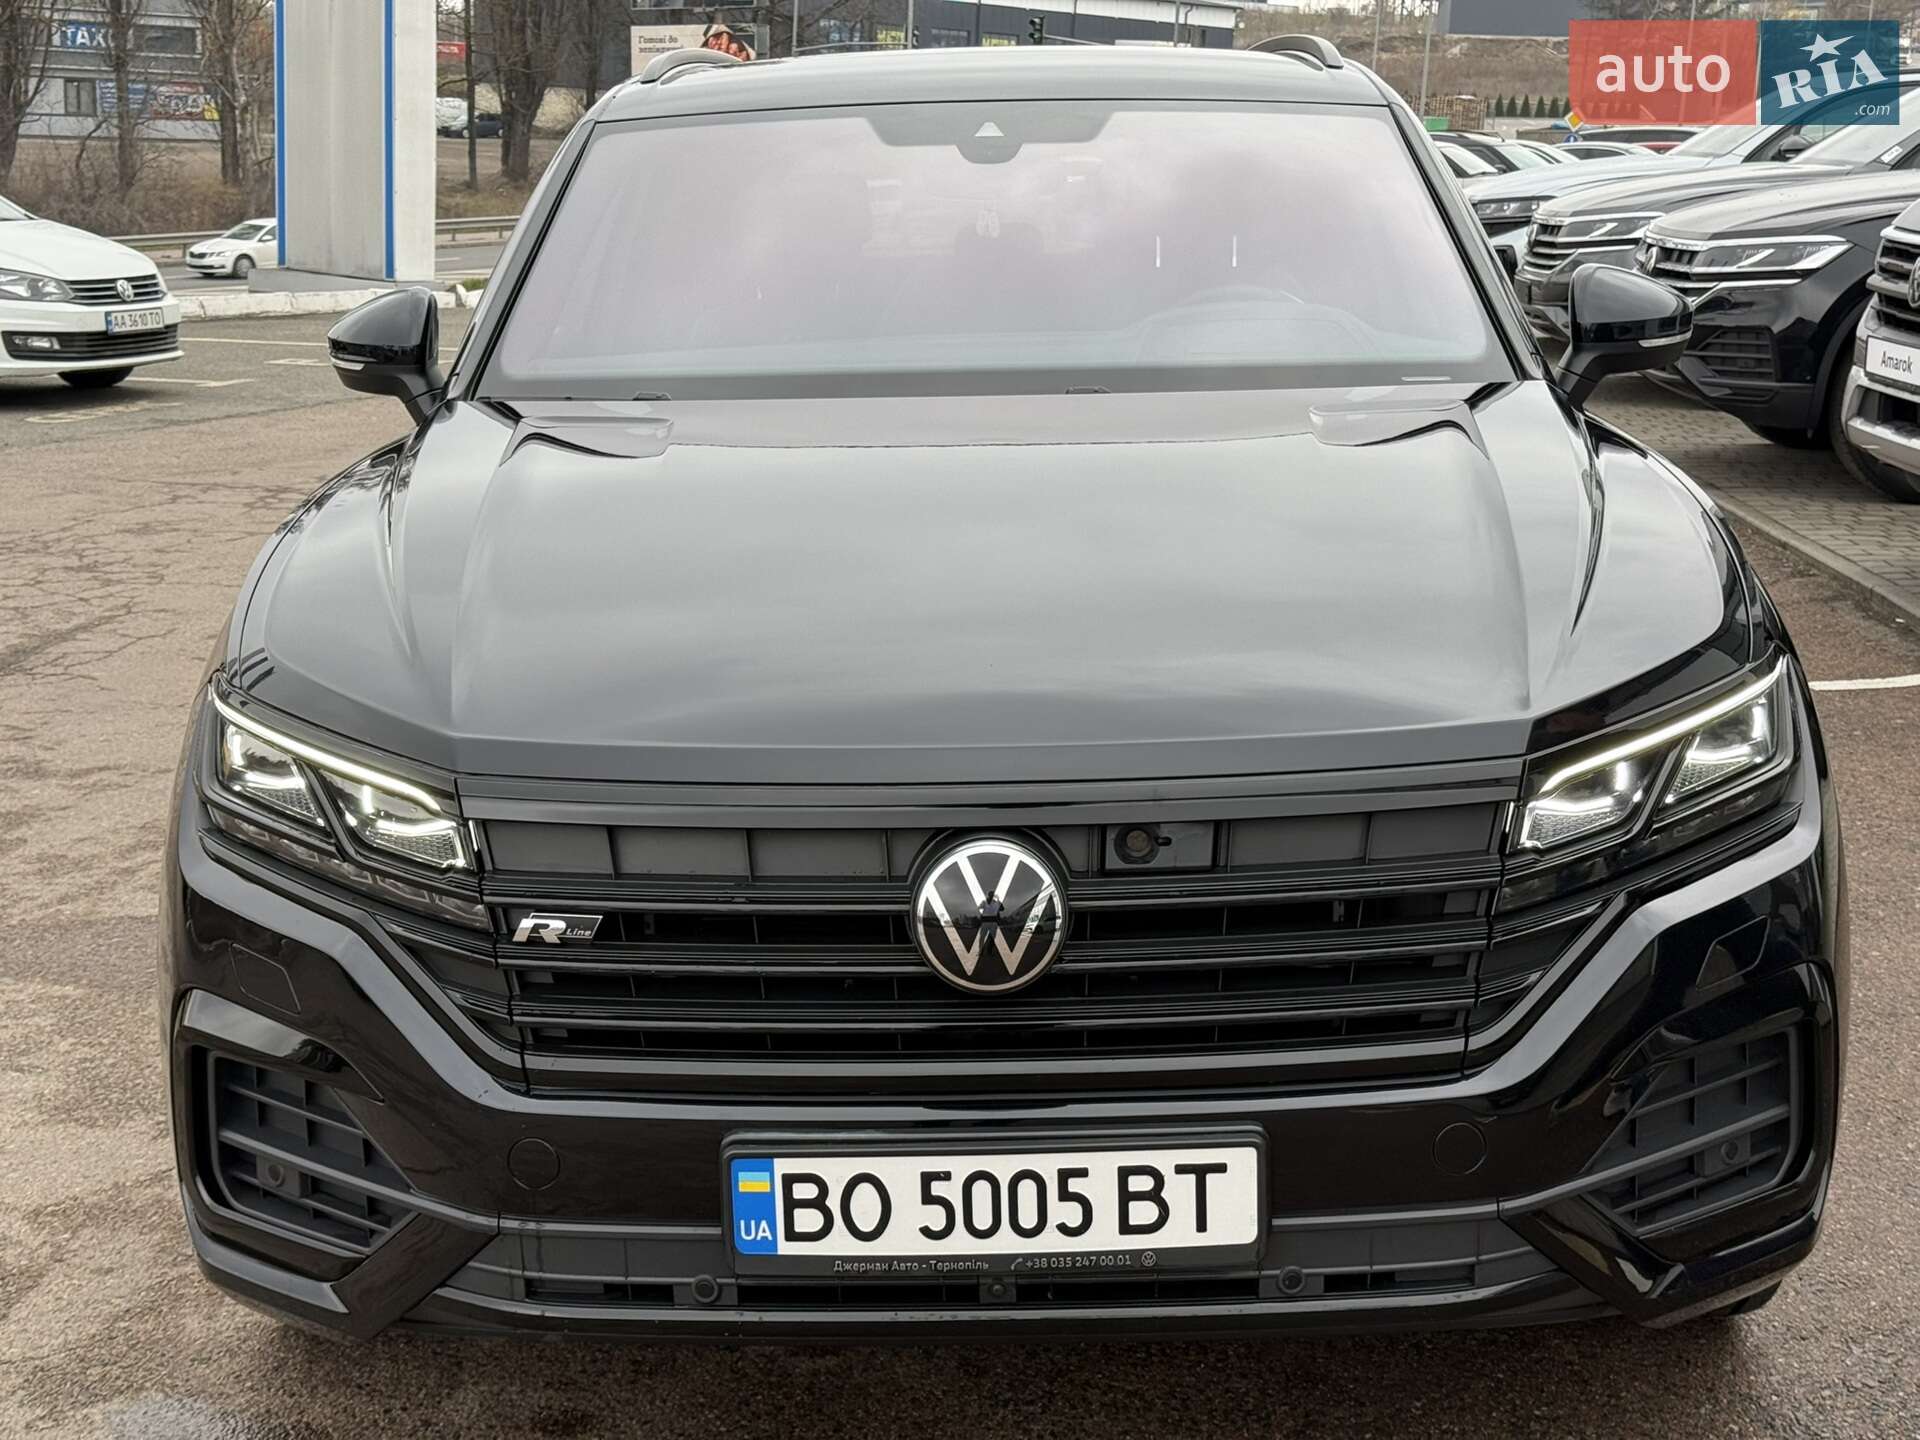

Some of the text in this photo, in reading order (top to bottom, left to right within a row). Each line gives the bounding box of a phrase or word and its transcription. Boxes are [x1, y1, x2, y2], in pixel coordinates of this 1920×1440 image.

[113, 315, 127, 329] AA
[149, 312, 161, 325] TO
[1880, 351, 1913, 374] Amarok
[512, 918, 592, 943] R Line
[781, 1162, 1228, 1242] BO 5005 BT
[740, 1219, 773, 1241] UA
[833, 1260, 889, 1272] Джерман
[891, 1260, 919, 1271] Авто
[929, 1259, 989, 1273] Тернопіль
[1025, 1254, 1132, 1268] +38 035 247 00 01
